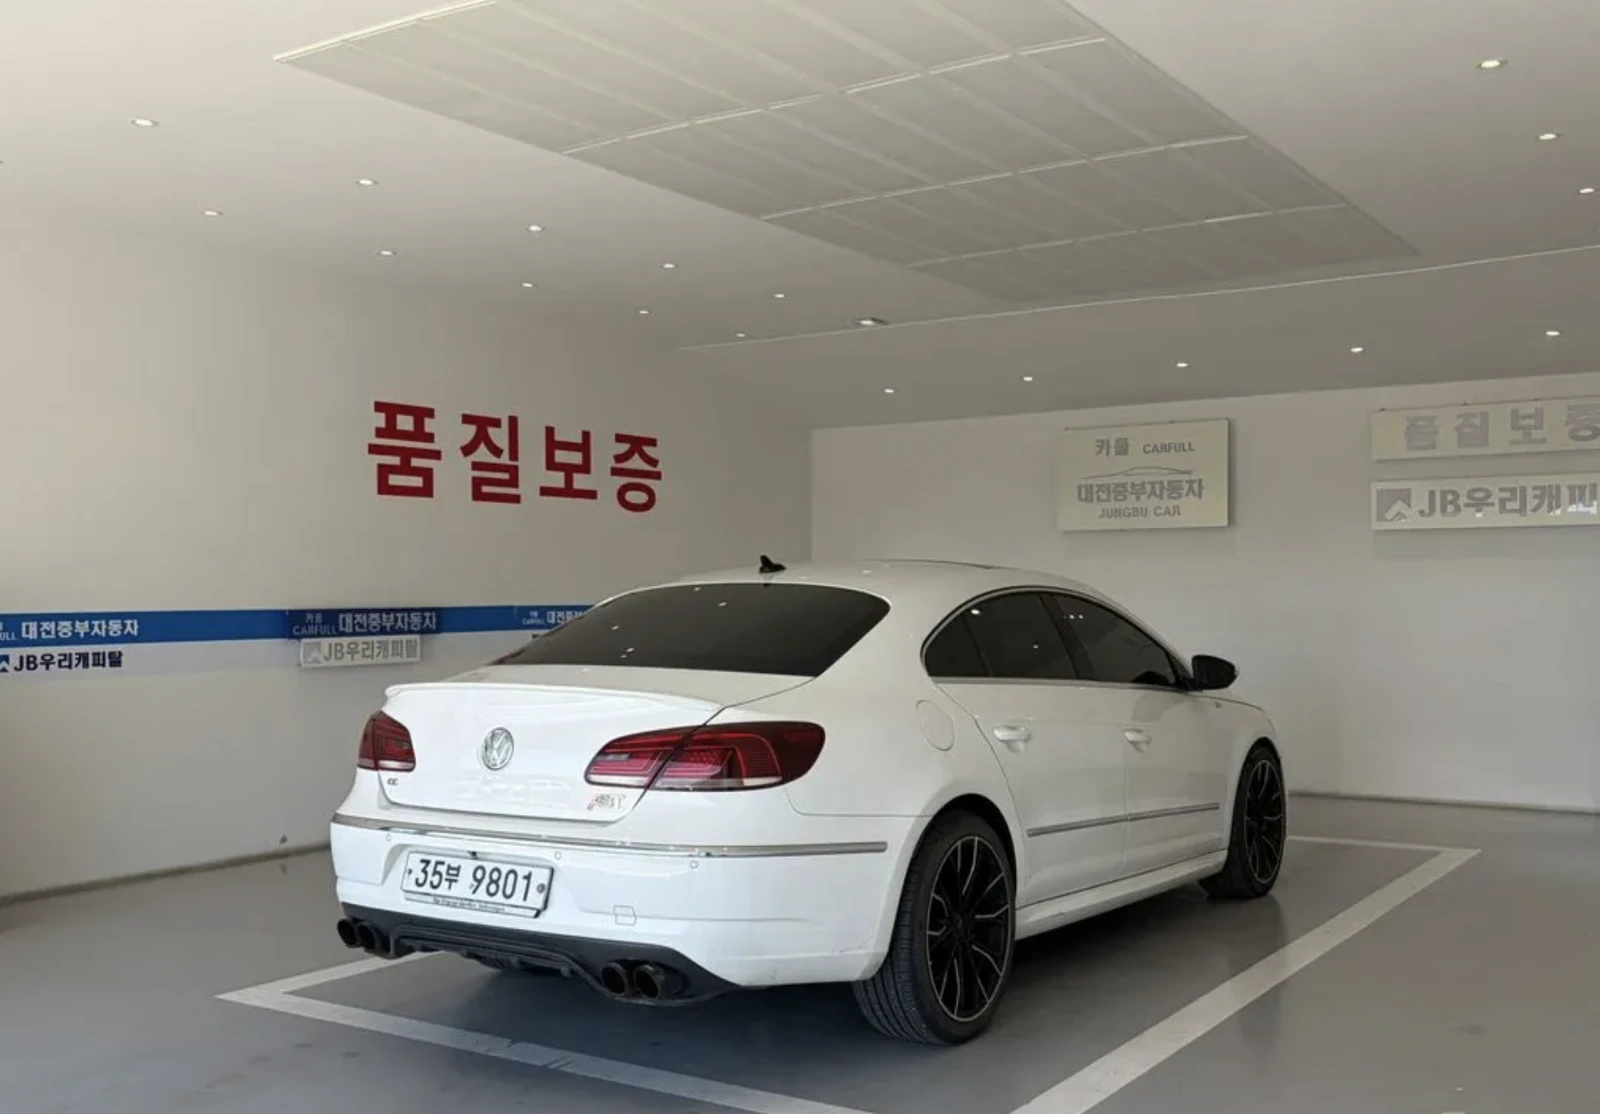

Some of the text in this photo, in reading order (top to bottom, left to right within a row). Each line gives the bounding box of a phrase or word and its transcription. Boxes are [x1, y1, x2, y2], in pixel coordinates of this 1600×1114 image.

[367, 400, 662, 513] 품질보증
[1142, 441, 1195, 455] CARFULL
[1098, 505, 1182, 519] JUNGBU CAR
[322, 637, 419, 662] JB우리캐피탈
[13, 651, 124, 672] JB우리캐피탈
[414, 858, 533, 903] 35부 9801
